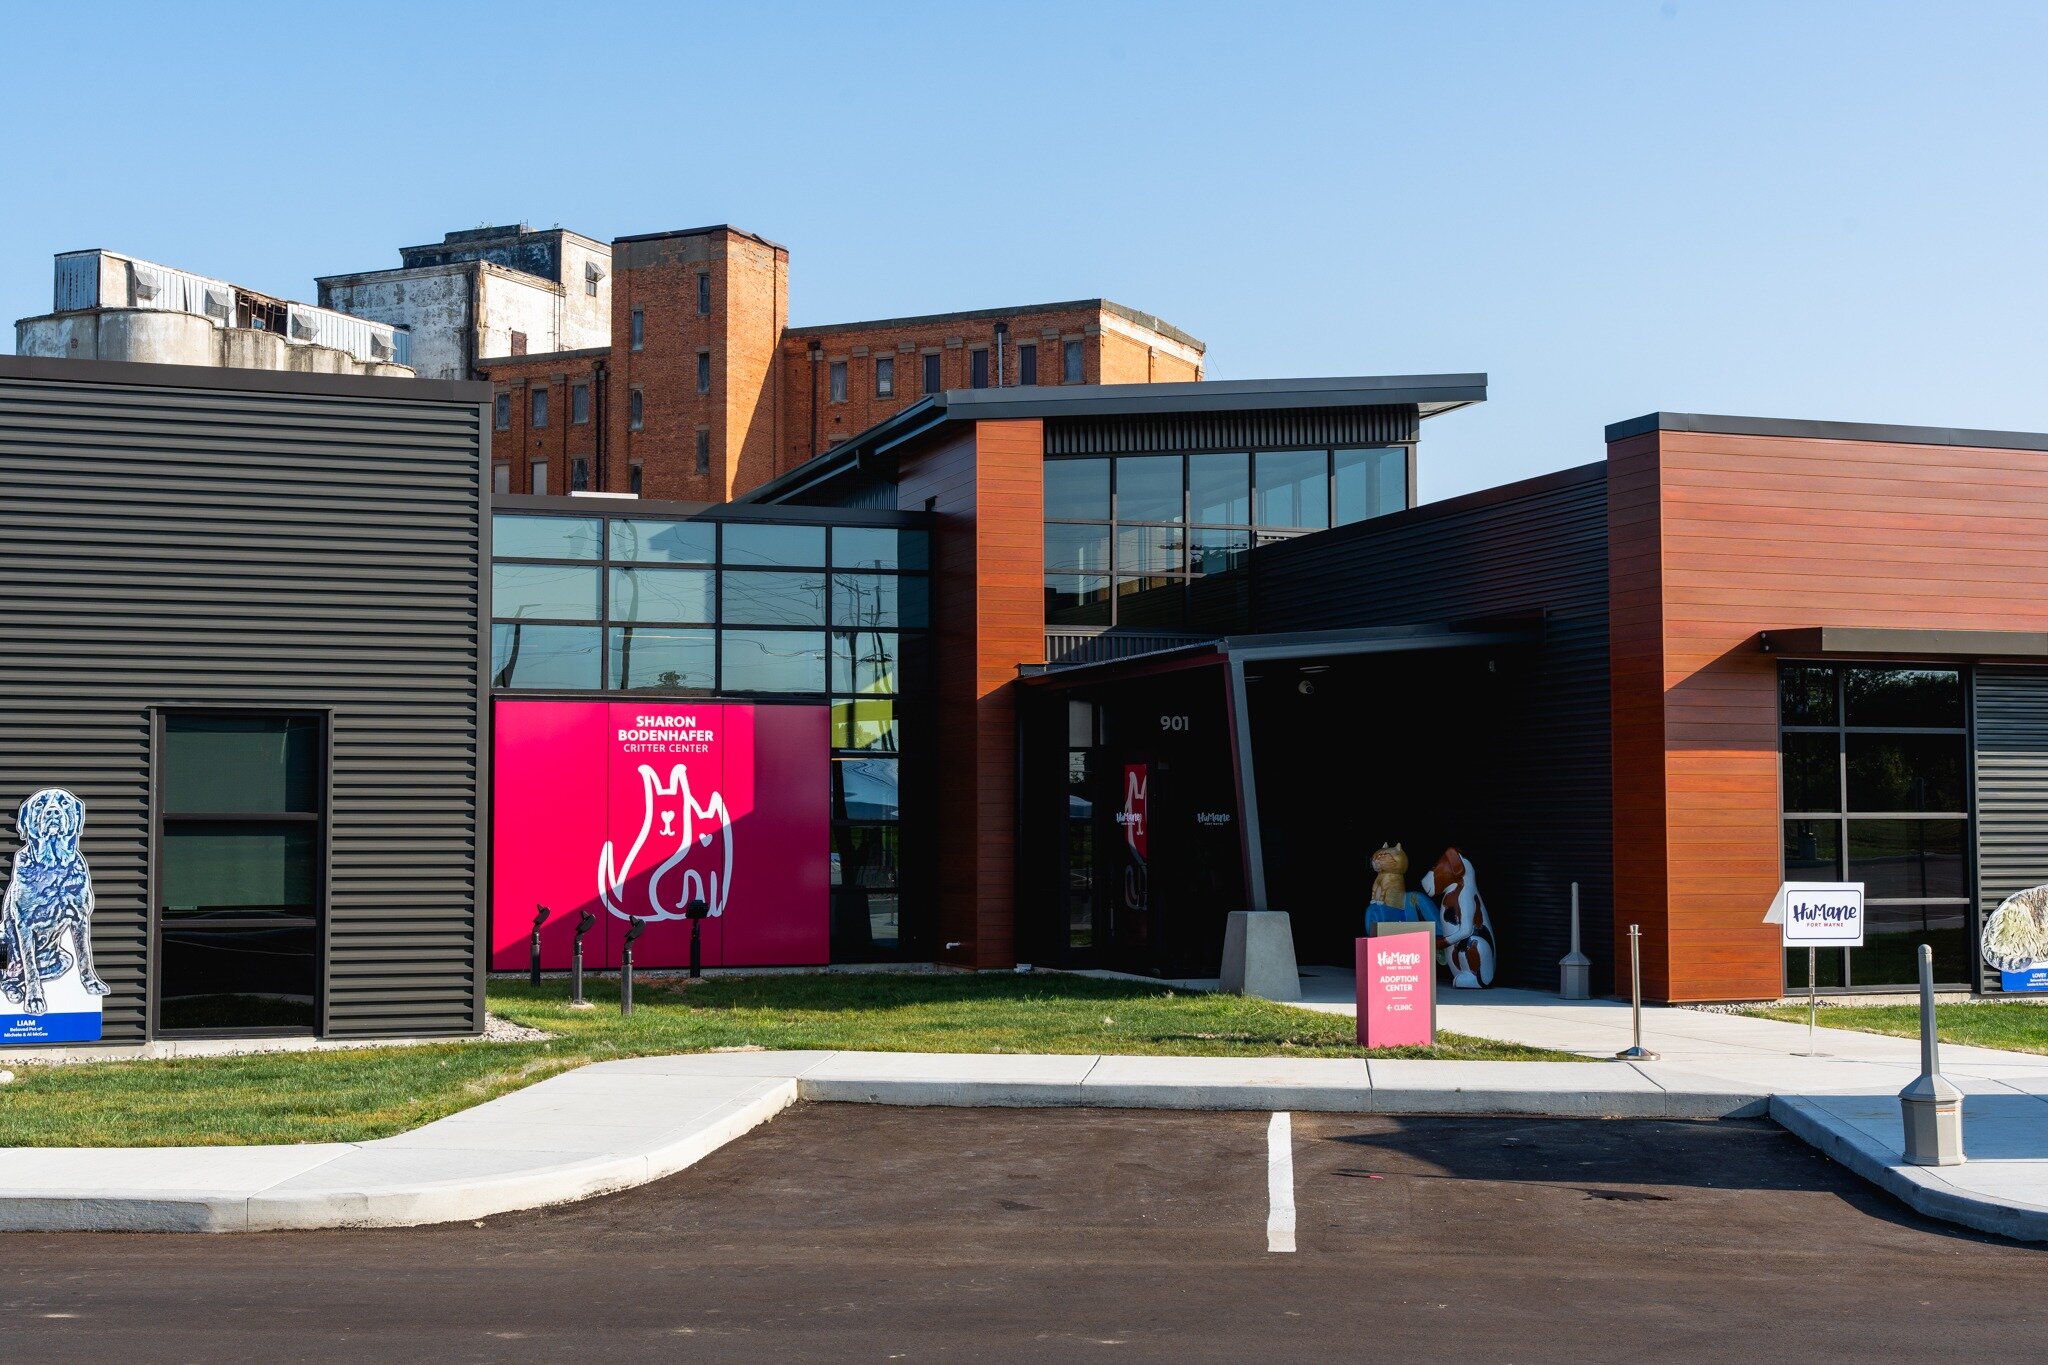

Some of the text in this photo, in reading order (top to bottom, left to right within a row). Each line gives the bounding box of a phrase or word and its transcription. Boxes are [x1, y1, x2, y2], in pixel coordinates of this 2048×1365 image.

[636, 715, 696, 727] SHARON
[1160, 715, 1189, 731] 901
[618, 729, 714, 741] BODENHAFER
[623, 743, 709, 753] CRITTER CENTER
[1380, 975, 1418, 983] ADOPTION
